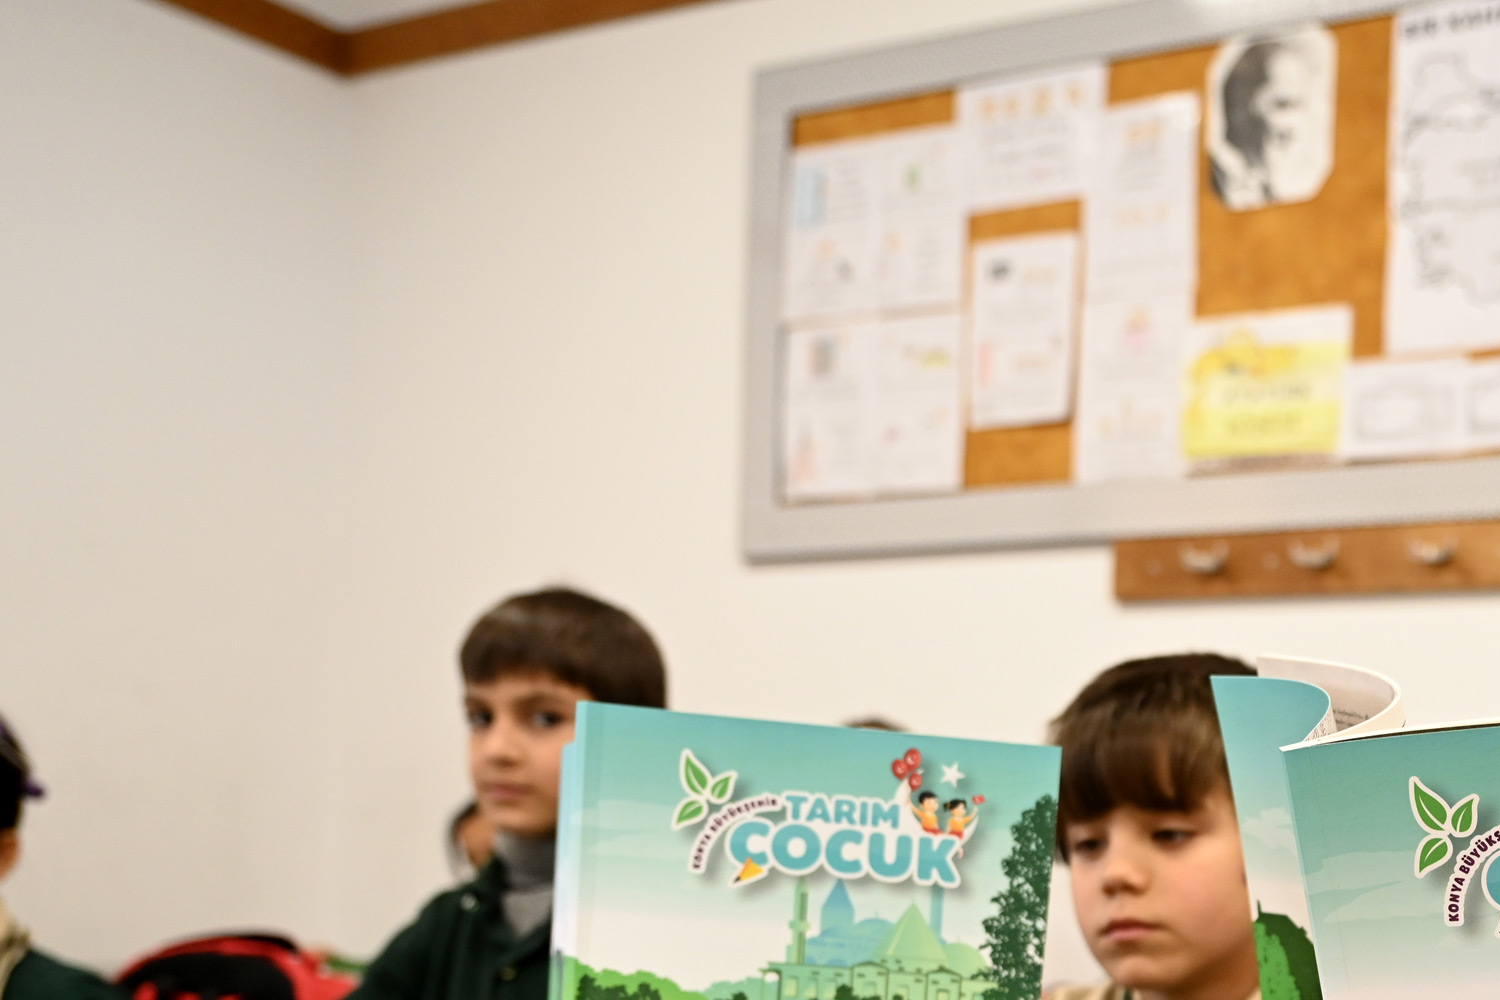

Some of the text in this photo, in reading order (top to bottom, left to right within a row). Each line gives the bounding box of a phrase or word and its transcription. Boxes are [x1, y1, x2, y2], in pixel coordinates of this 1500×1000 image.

[785, 794, 899, 829] TARIM
[729, 820, 957, 883] ÇOCUK
[1448, 876, 1466, 922] KONYA
